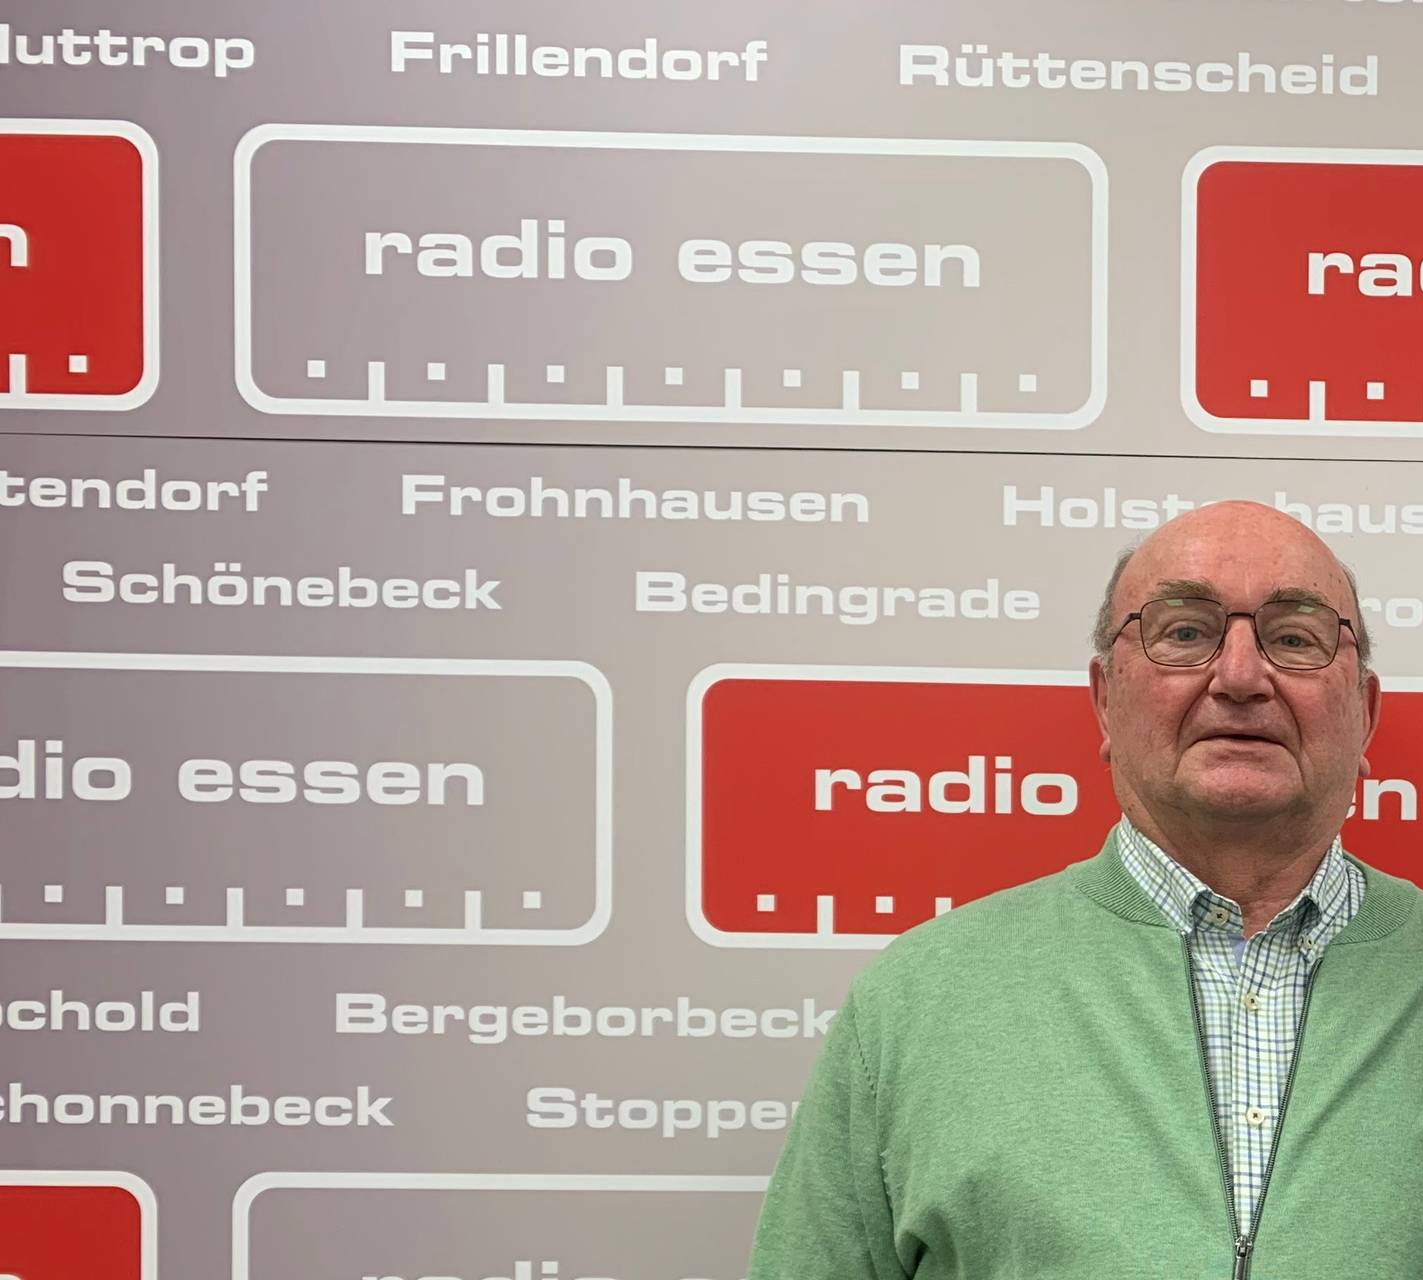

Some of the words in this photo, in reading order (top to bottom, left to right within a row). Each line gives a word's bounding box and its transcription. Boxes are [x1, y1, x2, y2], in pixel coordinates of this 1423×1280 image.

[0, 23, 255, 78] uttrop
[391, 31, 769, 82] Frillendorf
[899, 43, 1378, 96] Rüttenscheid
[365, 218, 633, 281] radio
[678, 239, 981, 288] essen
[402, 474, 870, 523] Frohnhausen
[63, 560, 503, 610] Schönebeck
[635, 571, 1041, 625] Bedingrade
[178, 759, 484, 806] essen
[815, 755, 1078, 816] radio
[0, 989, 200, 1032] chold
[335, 992, 837, 1044] Bergeborbeck
[0, 1082, 395, 1127] honnebeck
[526, 1087, 800, 1138] Stoppe
